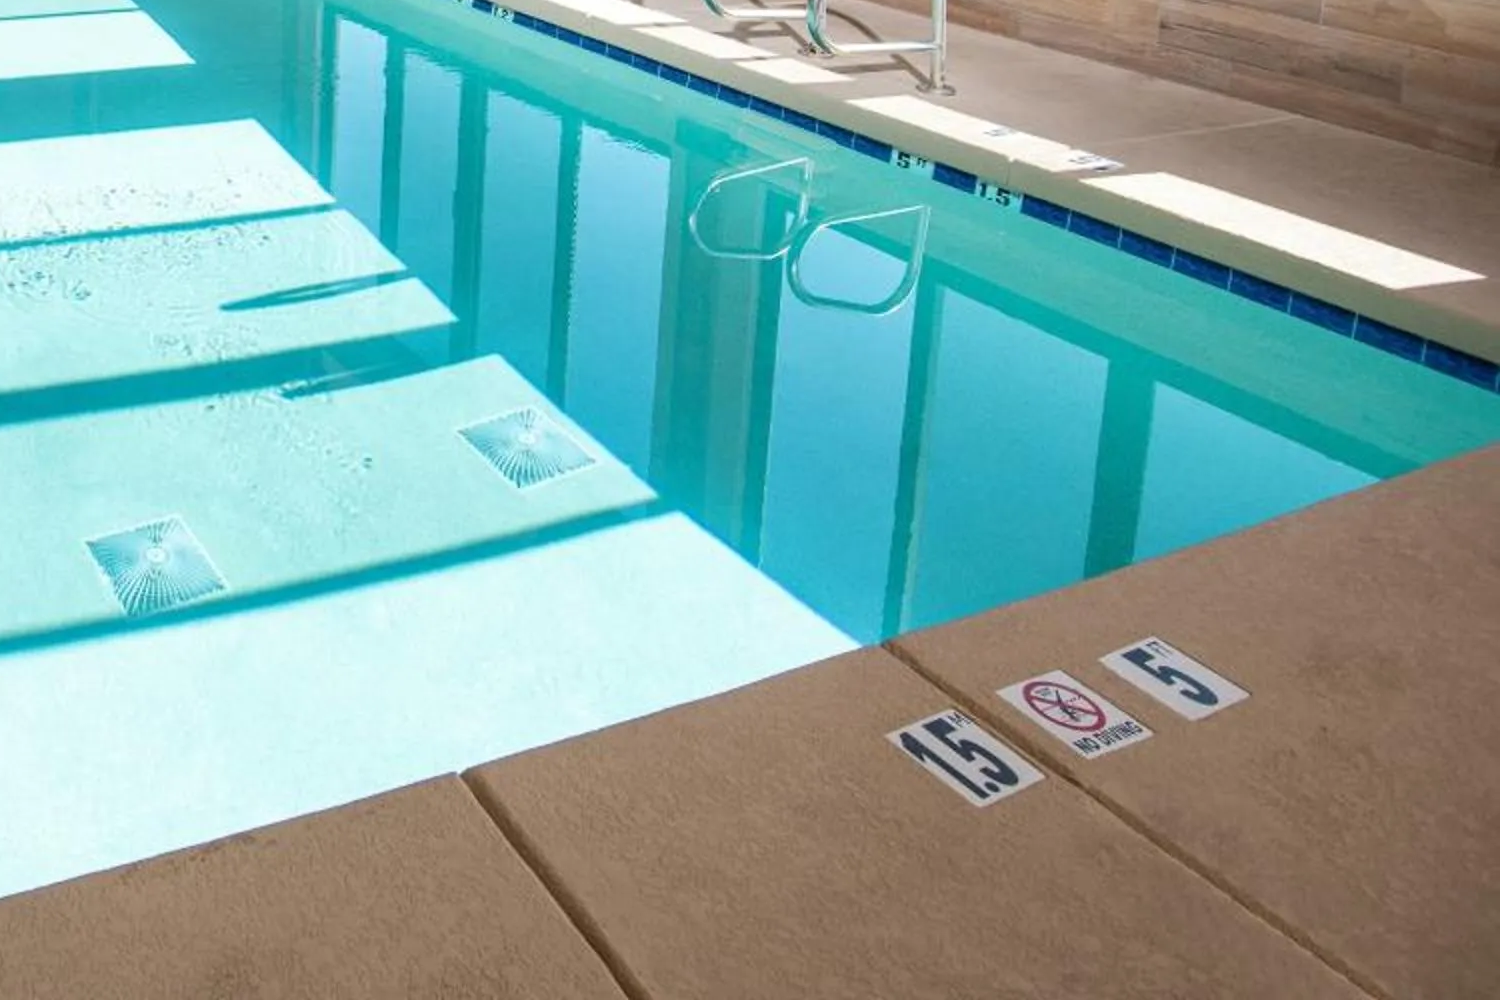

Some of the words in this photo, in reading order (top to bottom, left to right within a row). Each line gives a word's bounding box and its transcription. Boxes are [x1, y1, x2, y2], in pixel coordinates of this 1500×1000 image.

[897, 151, 910, 168] 5
[980, 183, 1010, 206] 1.5
[1121, 648, 1219, 706] 5
[1073, 737, 1100, 754] NO
[1092, 721, 1143, 745] DIVING
[899, 718, 1019, 799] 1.5
